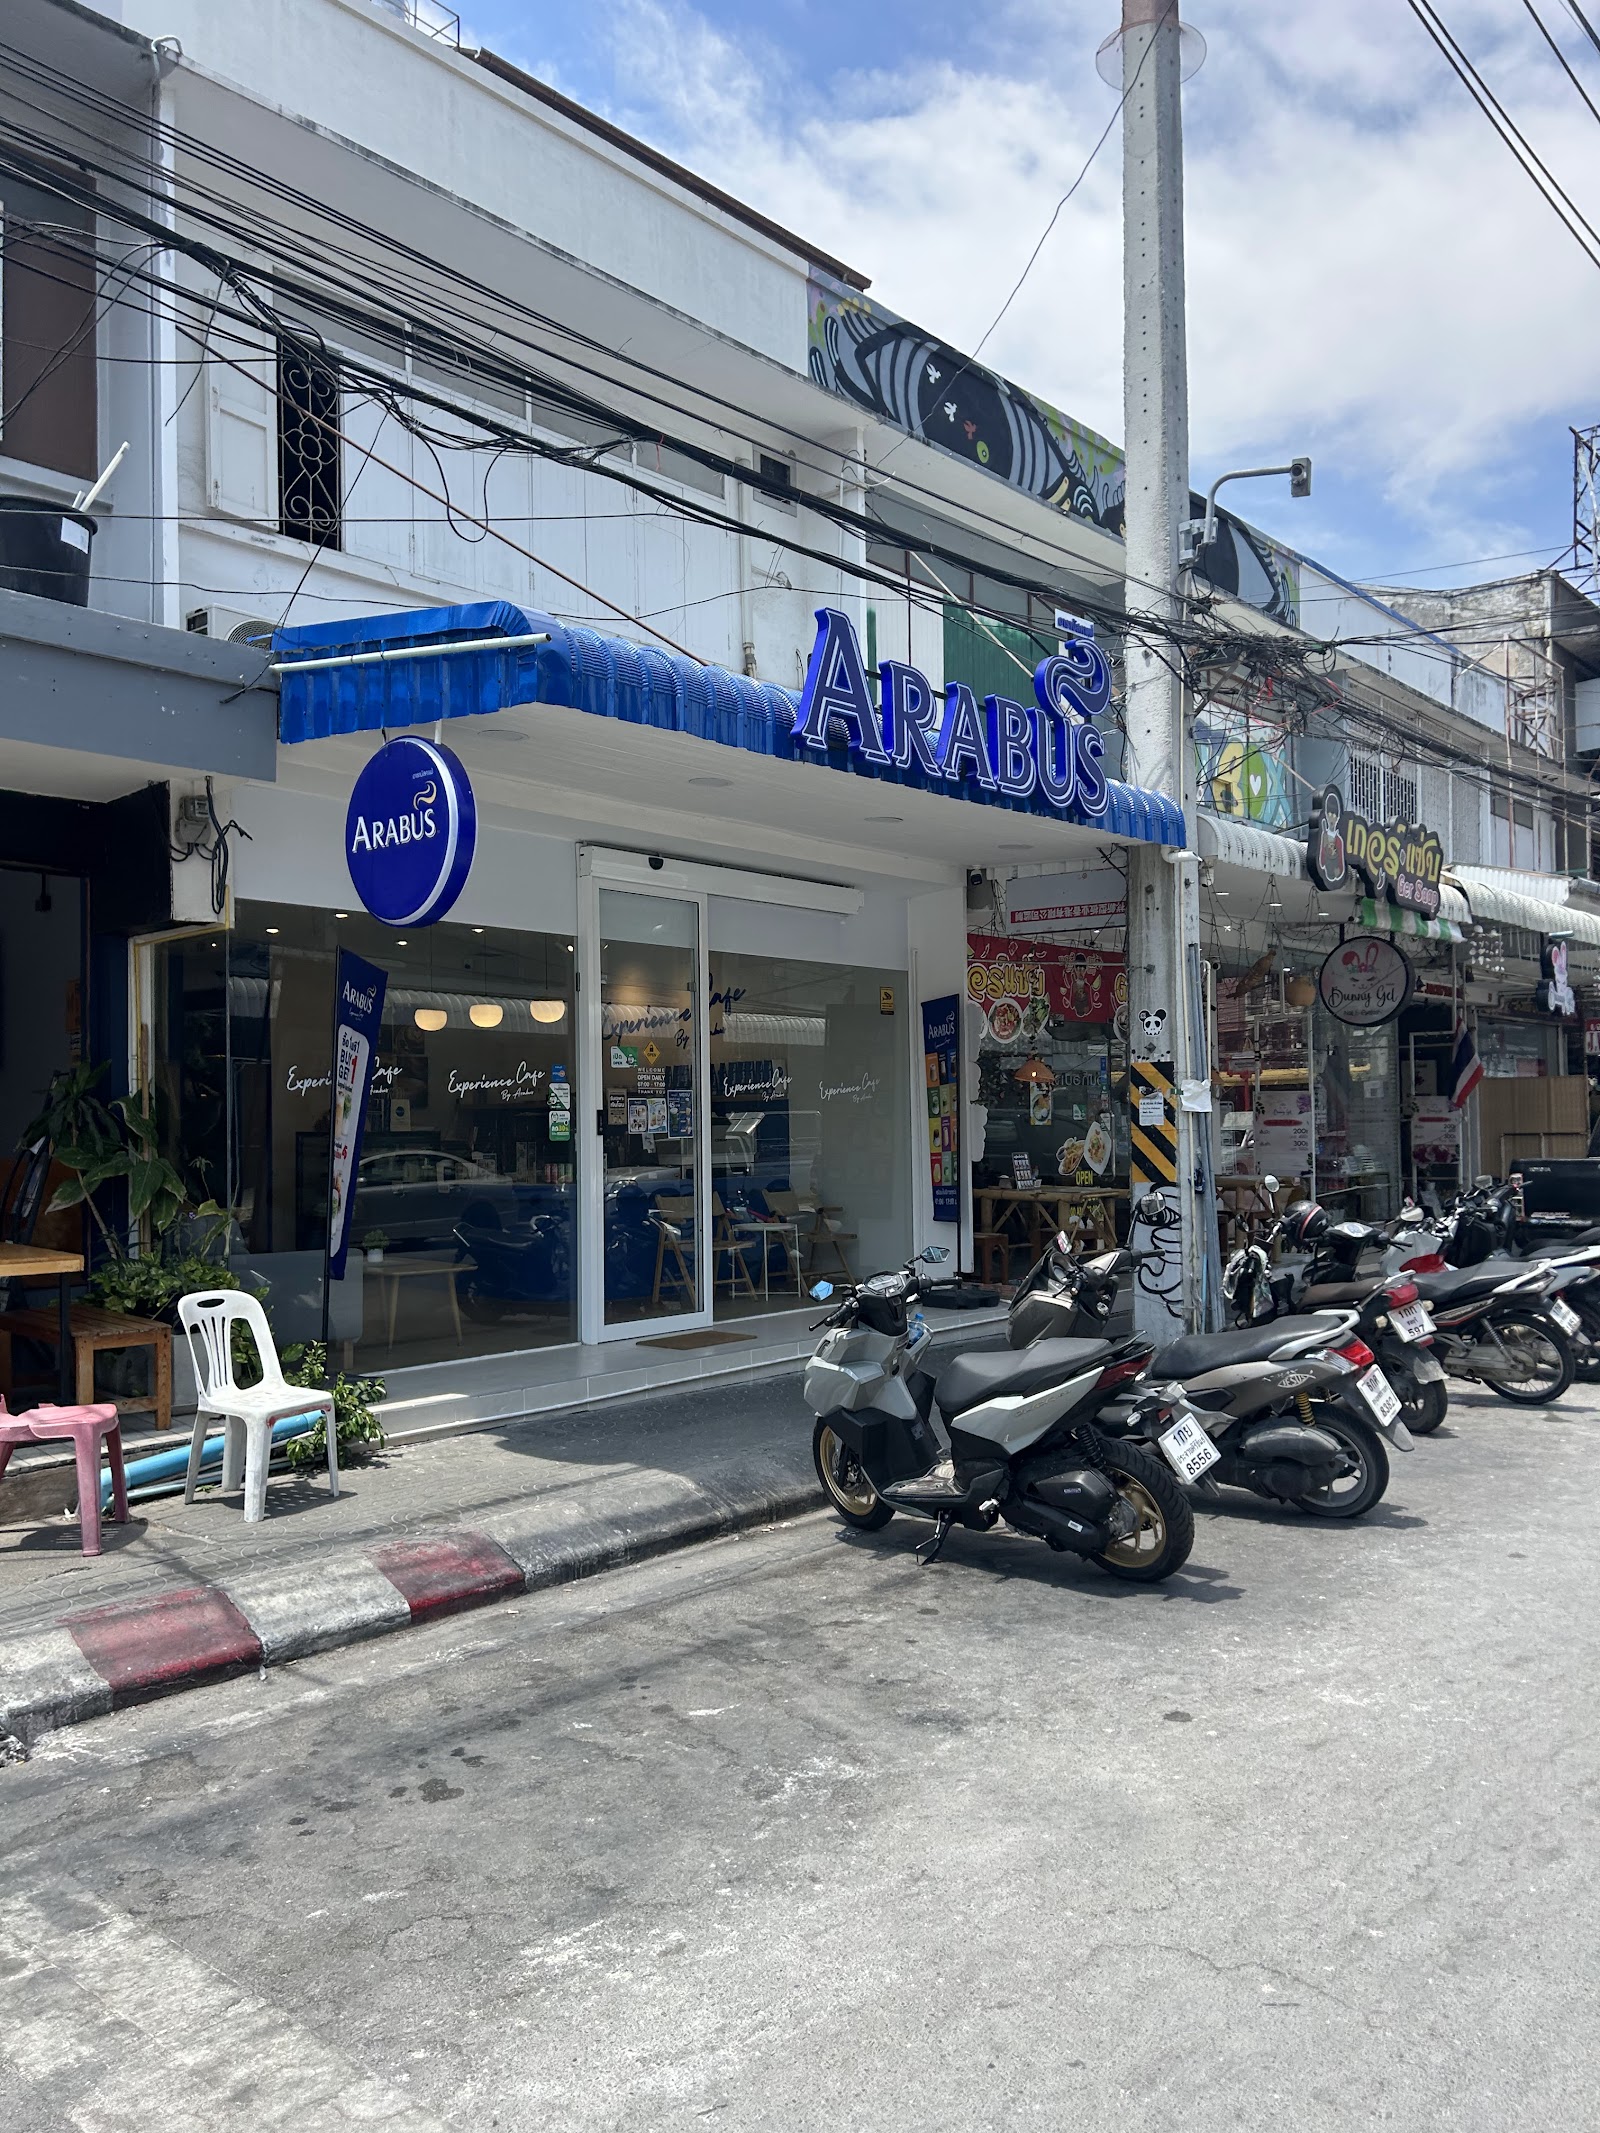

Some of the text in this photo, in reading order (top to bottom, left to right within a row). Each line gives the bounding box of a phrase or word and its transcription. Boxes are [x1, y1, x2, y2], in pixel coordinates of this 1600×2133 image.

[790, 607, 1110, 819] ARABUS
[352, 808, 437, 853] ARABUS
[1397, 873, 1414, 900] Ger
[342, 980, 374, 1015] ARABUS
[1328, 986, 1371, 1008] Bunny
[674, 1028, 690, 1049] By
[928, 1022, 955, 1039] ARABUS
[447, 1069, 515, 1099] Experience
[516, 1060, 546, 1087] Cafe
[723, 1068, 793, 1098] Experience Cafe
[819, 1072, 881, 1101] Experience Cafe
[500, 1089, 511, 1102] By
[1075, 1170, 1094, 1186] OPEN
[1407, 1323, 1426, 1337] 597
[1186, 1448, 1212, 1475] 8556
